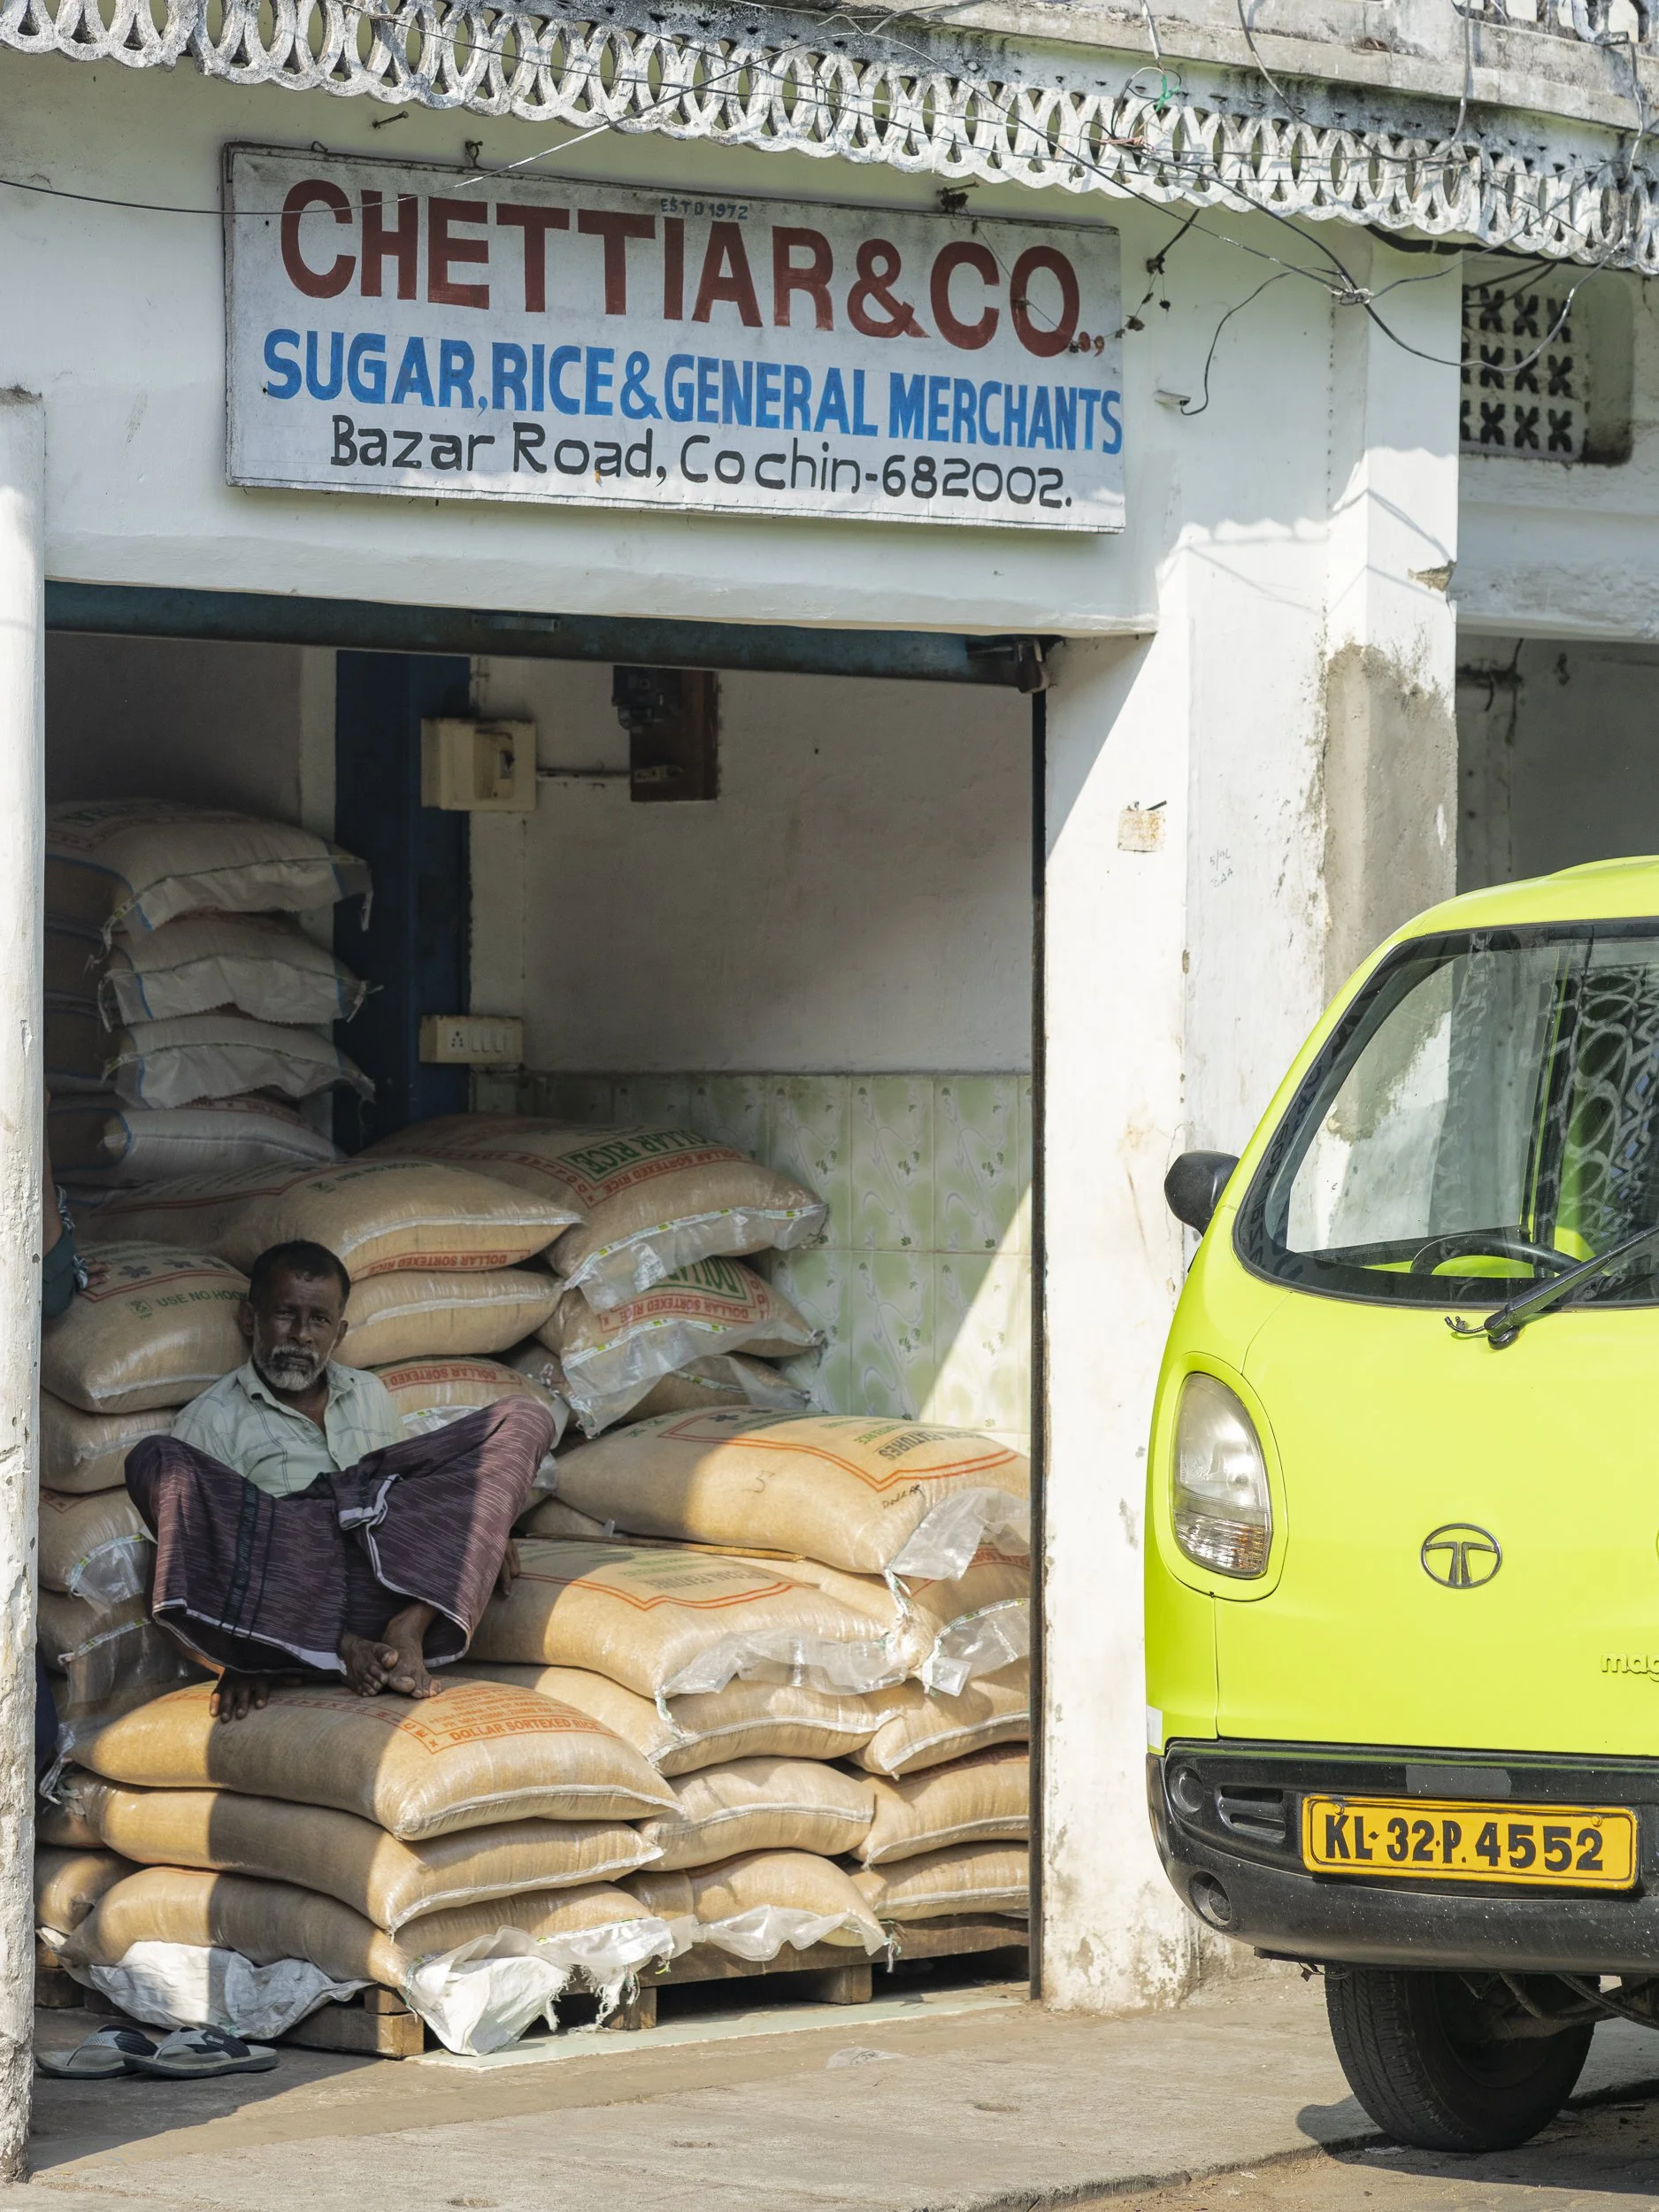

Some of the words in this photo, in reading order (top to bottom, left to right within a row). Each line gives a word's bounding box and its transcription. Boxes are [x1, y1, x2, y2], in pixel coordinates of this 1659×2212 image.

[709, 203, 749, 220] 1972
[888, 372, 1122, 455] MERCHANTS
[330, 414, 495, 472] Bazar
[512, 421, 667, 487] Road,
[569, 1141, 642, 1176] RICE
[603, 1174, 632, 1194] RICE
[459, 1254, 508, 1266] DOLLAR
[155, 1292, 188, 1308] USE
[188, 1289, 211, 1302] NO
[647, 1297, 702, 1313] SORTEXED
[703, 1301, 749, 1319] DOLLAR
[389, 1370, 450, 1388] SORTEXED
[453, 1370, 497, 1381] DOLLAR
[449, 1722, 505, 1741] DOLLAR
[507, 1717, 572, 1732] SORTEXED
[572, 1718, 603, 1732] RICE
